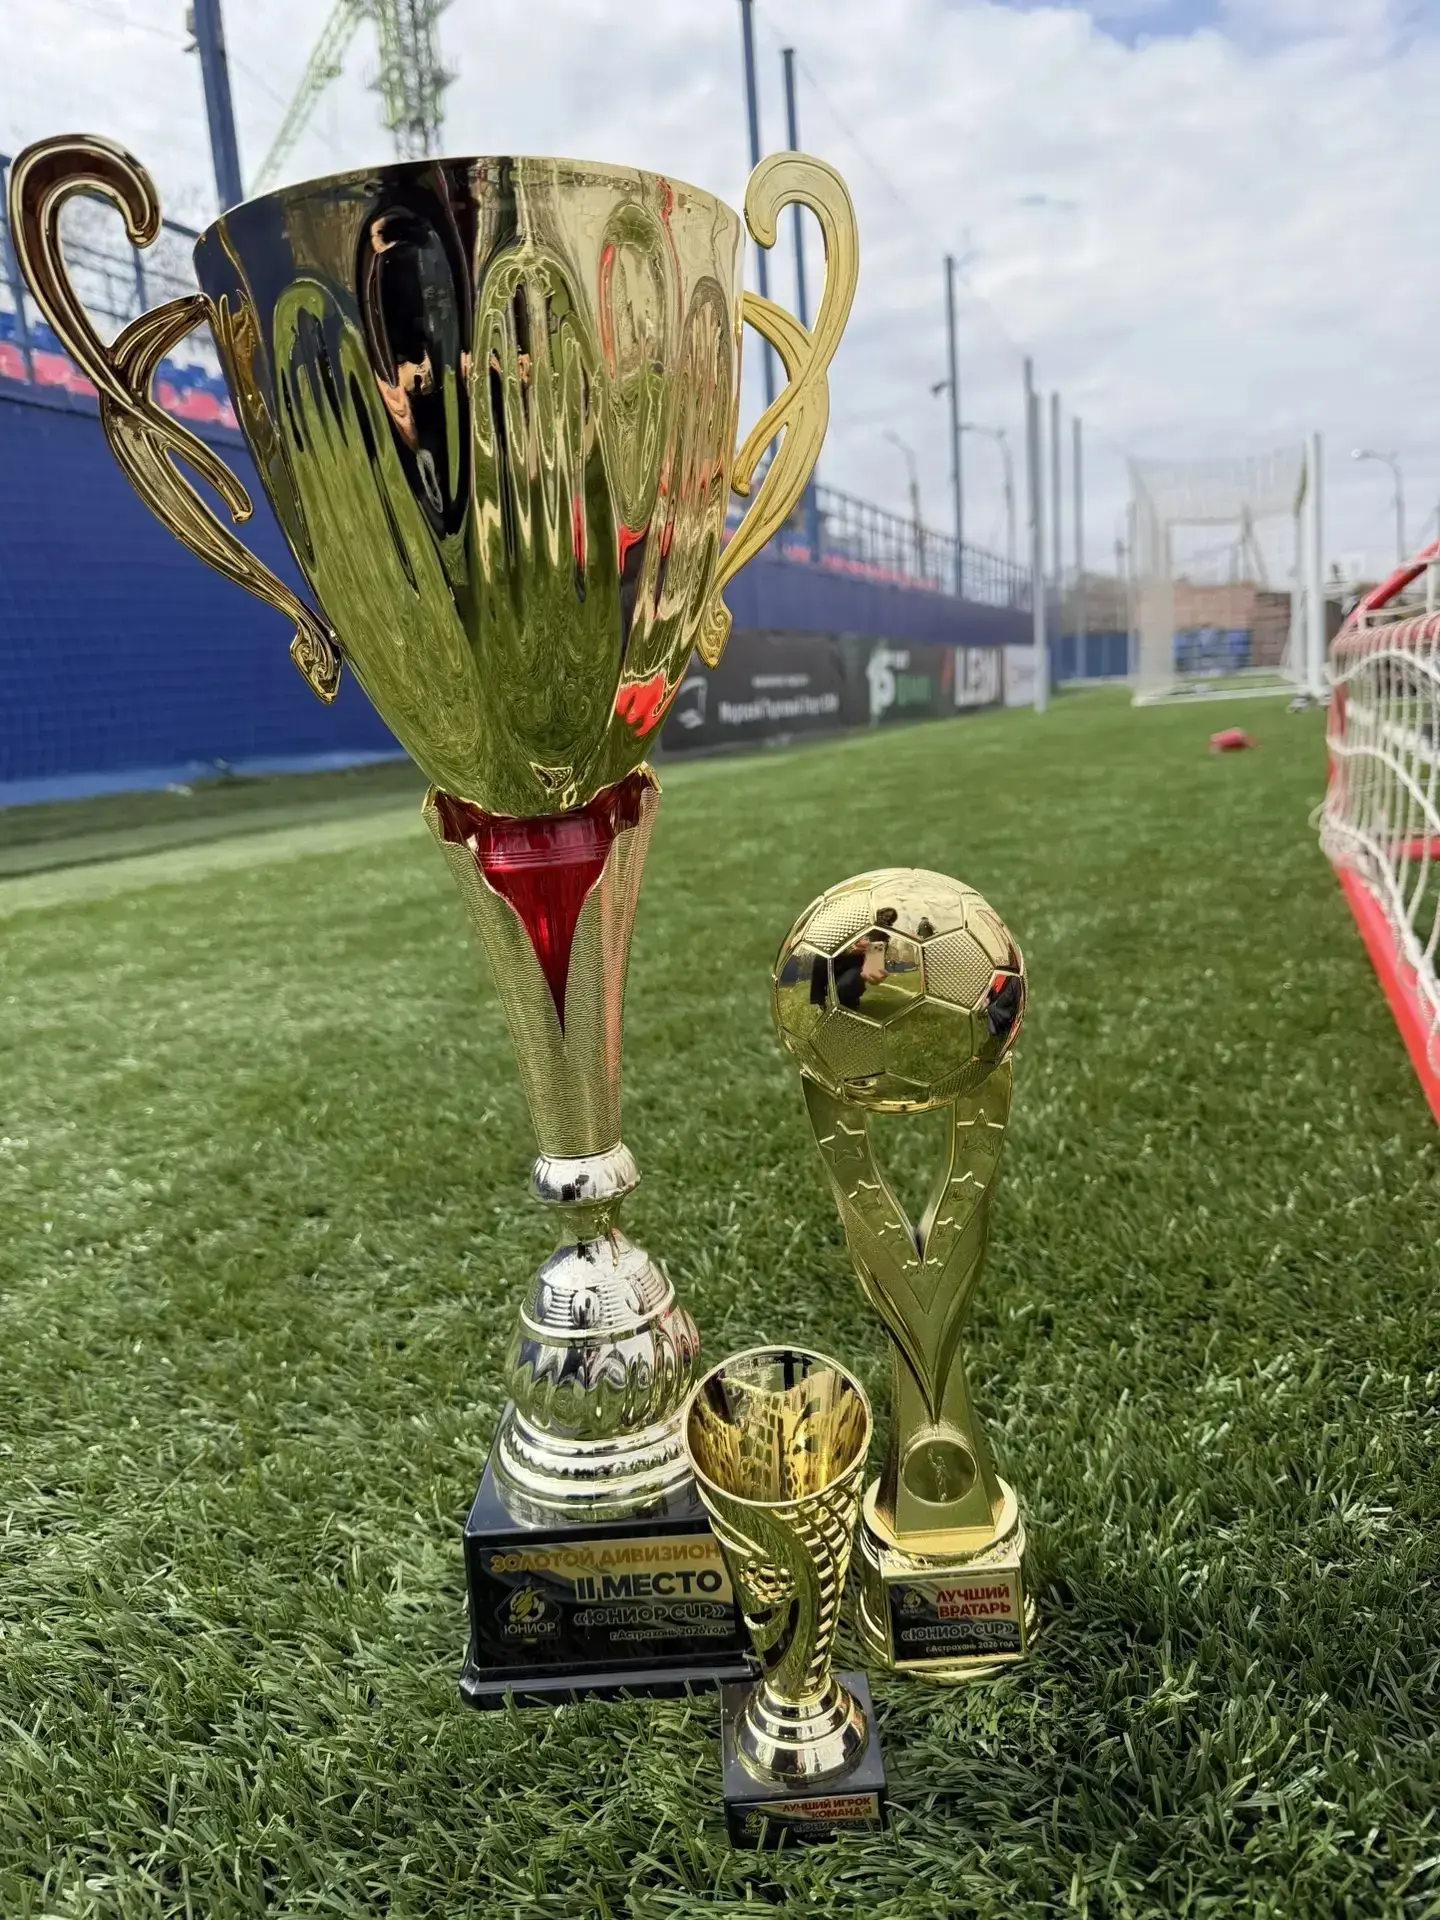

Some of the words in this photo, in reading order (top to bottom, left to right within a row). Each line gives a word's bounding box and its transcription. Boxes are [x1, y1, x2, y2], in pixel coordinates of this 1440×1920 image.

[490, 1547, 595, 1573] ЗОЛОТОЙ
[597, 1543, 720, 1568] ДИВИЗИОН
[602, 1569, 723, 1599] МЕСТО
[936, 1584, 1010, 1603] ЛУЧШИЙ
[573, 1605, 668, 1626] «ЮНИОР
[669, 1602, 726, 1620] CUP»
[937, 1602, 1011, 1619] ВРАТАРЬ
[503, 1622, 556, 1636] ЮНИОР
[901, 1625, 972, 1641] «ЮНИОР
[972, 1622, 1014, 1636] CUP»
[978, 1641, 998, 1649] 2026
[783, 1799, 832, 1812] ЛУЧШИЙ
[833, 1797, 871, 1808] ИГРОК
